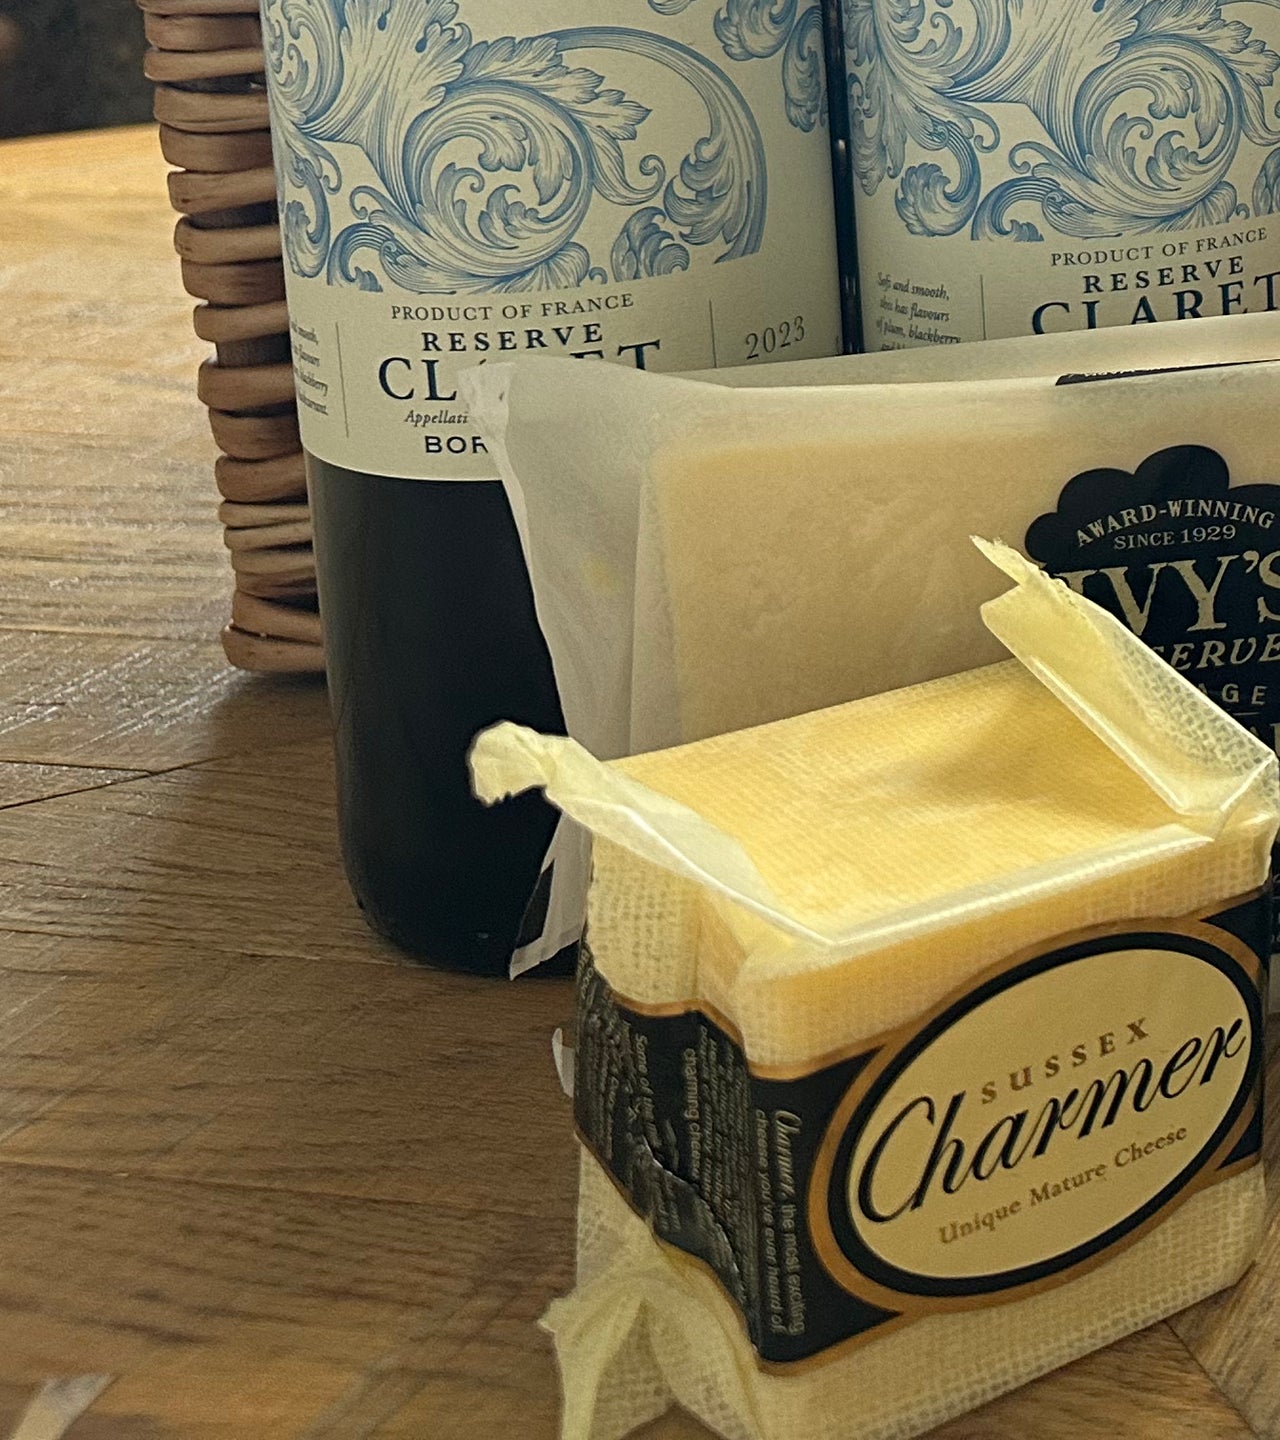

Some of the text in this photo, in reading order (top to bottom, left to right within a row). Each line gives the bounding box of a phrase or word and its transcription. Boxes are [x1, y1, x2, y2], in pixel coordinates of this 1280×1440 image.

[1050, 227, 1268, 267] PRODUCT OF FRANCE
[911, 284, 950, 301] smooth,
[1083, 255, 1245, 294] RESERVE
[391, 293, 634, 321] PRODUCT OF FRANCE
[908, 302, 950, 322] flavours
[421, 315, 805, 360] RESERVE 2023
[404, 409, 469, 428] Appellati
[424, 435, 489, 453] BOR
[1076, 498, 1276, 548] AWARD-WINNING
[1112, 524, 1237, 550] SINCE 1929
[683, 1047, 702, 1120] charming
[755, 1108, 773, 1169] cheese
[857, 1015, 1248, 1223] Charmer
[938, 1124, 1189, 1248] Unique Mature Cheese
[781, 1203, 799, 1229] the
